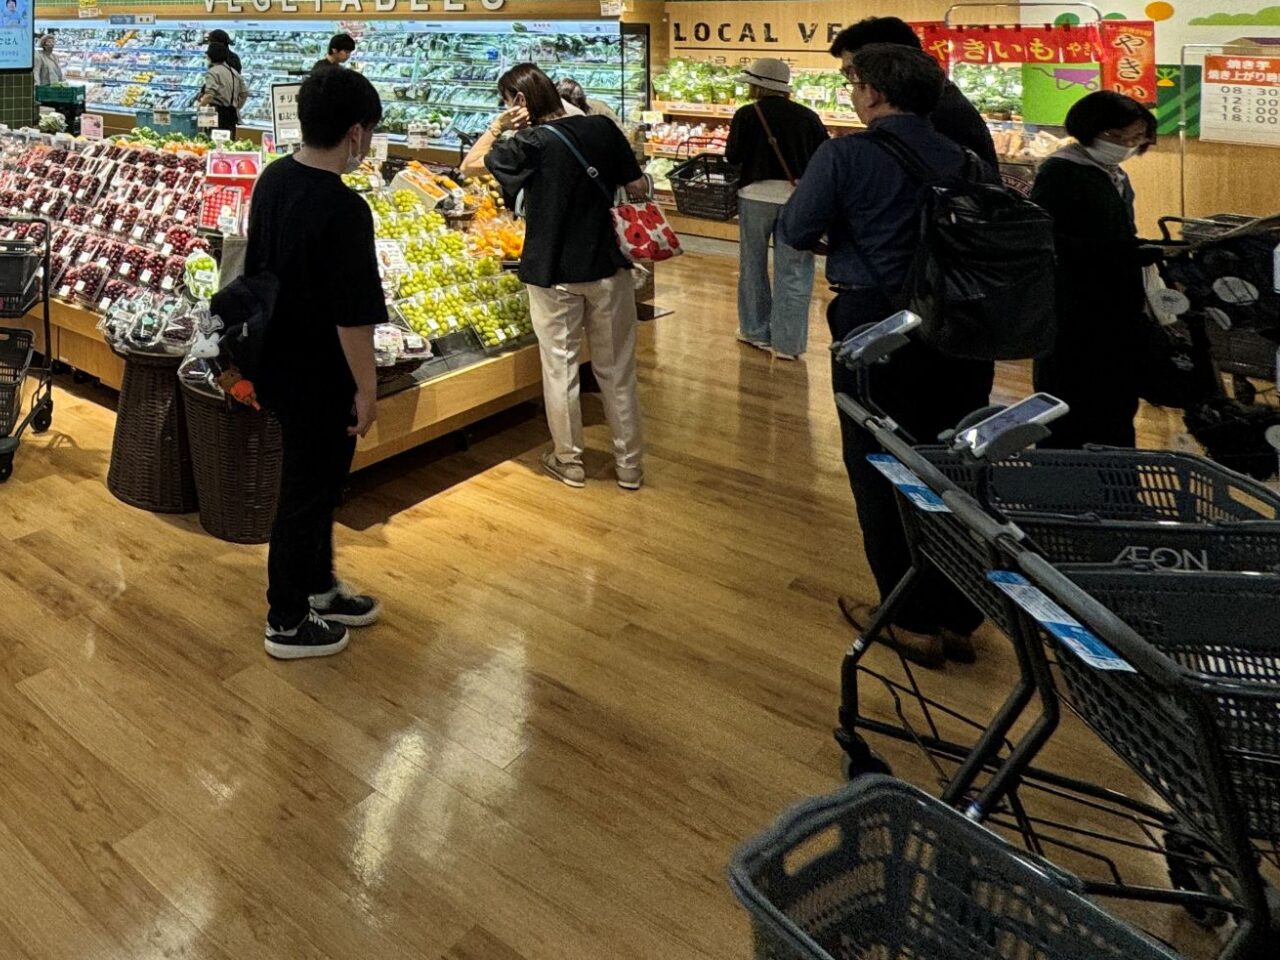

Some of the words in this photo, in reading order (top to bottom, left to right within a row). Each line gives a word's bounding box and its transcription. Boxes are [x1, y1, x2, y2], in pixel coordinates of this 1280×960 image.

[673, 22, 779, 43] LOCAL
[929, 37, 1055, 61] やきいも
